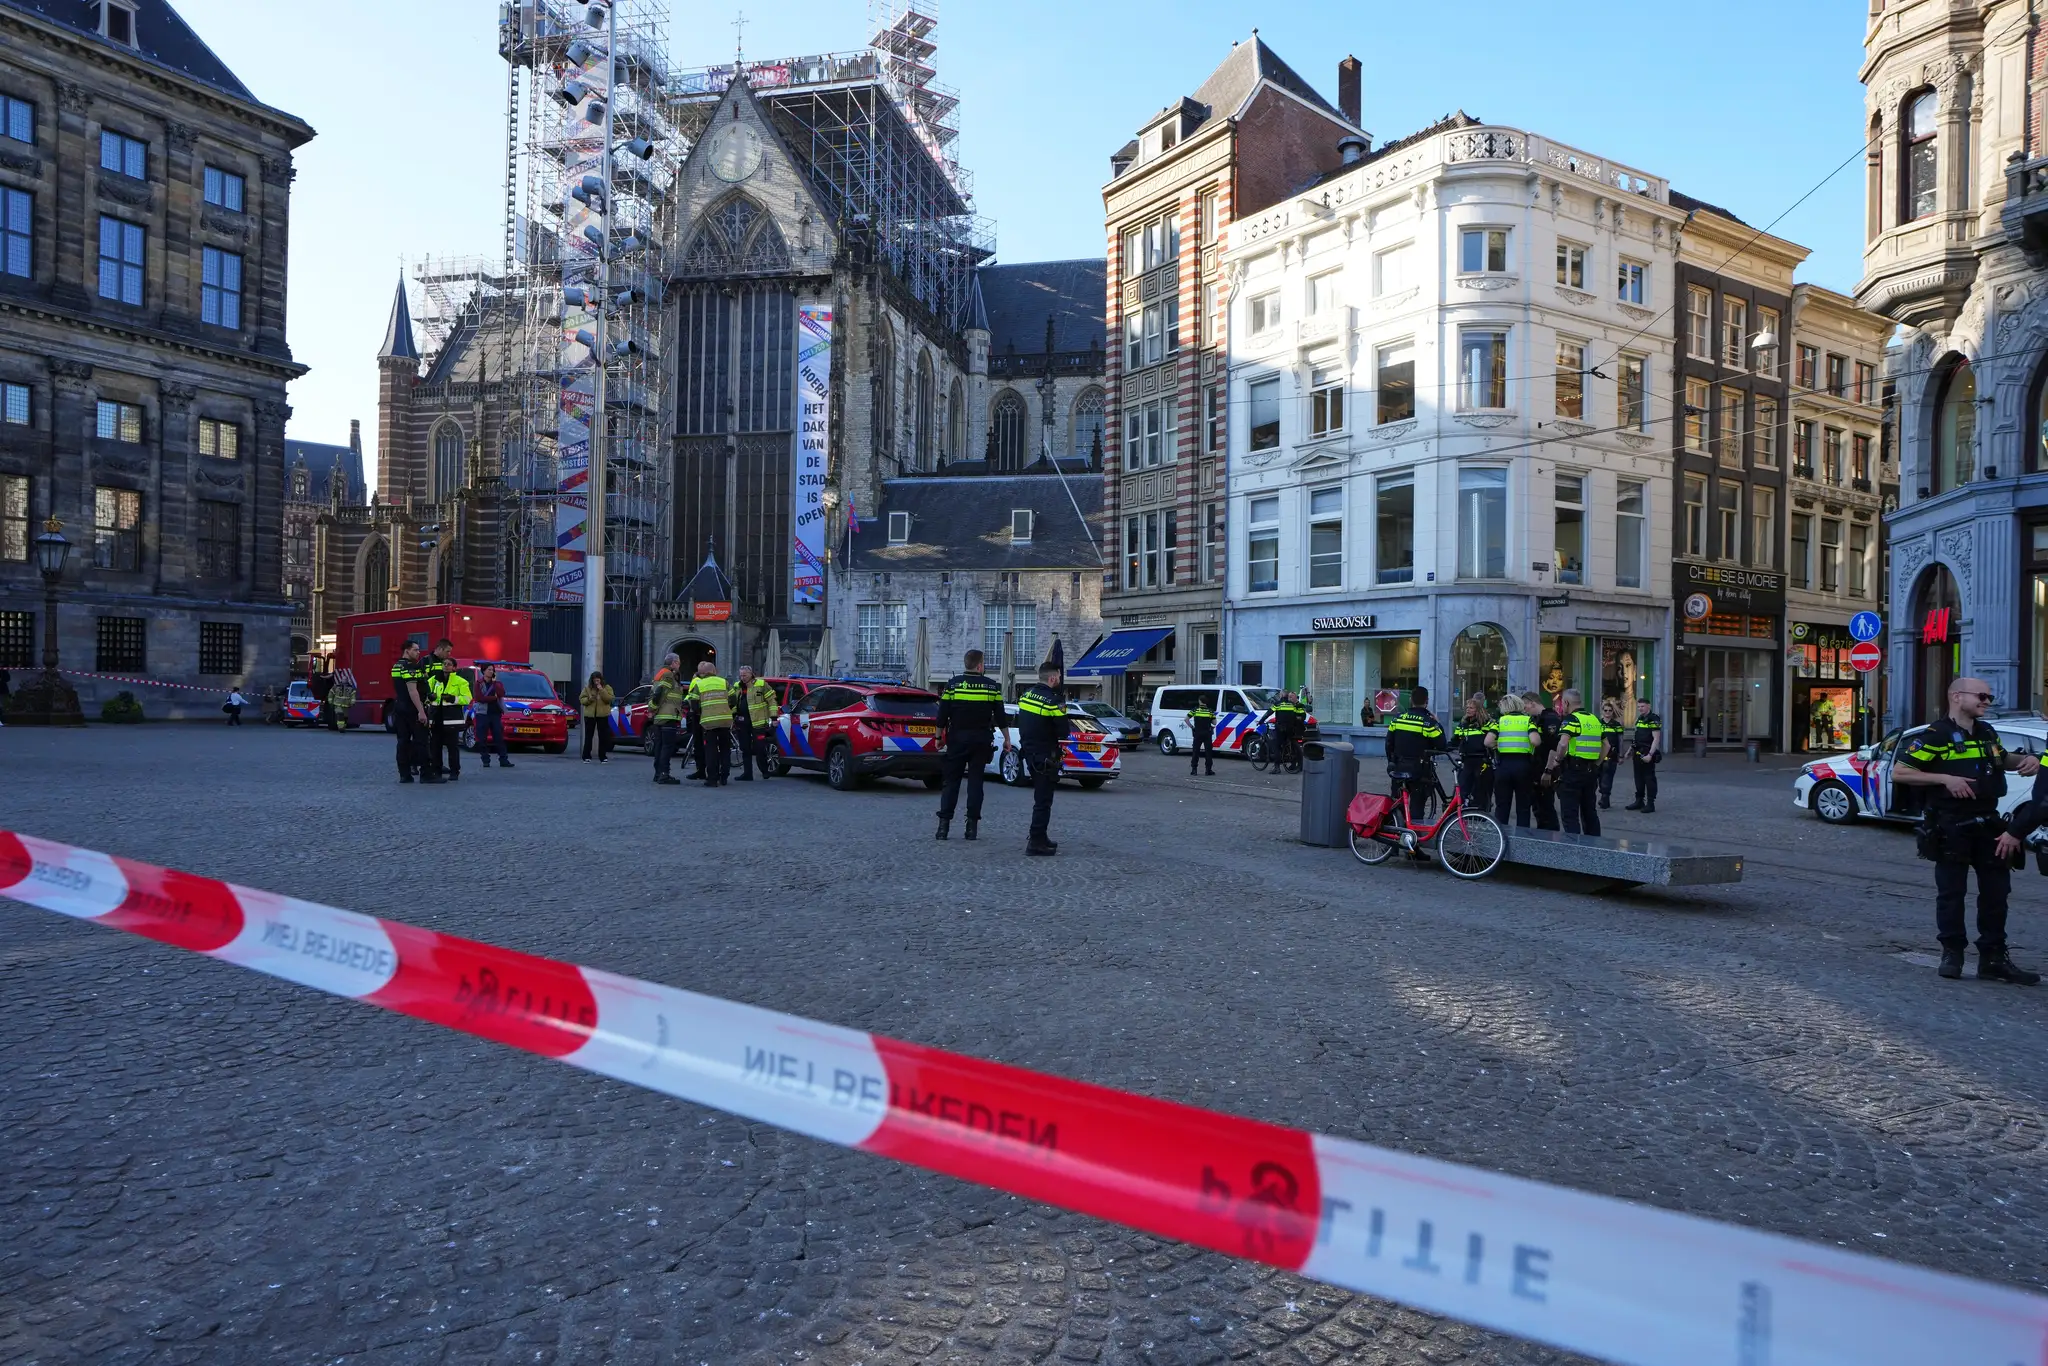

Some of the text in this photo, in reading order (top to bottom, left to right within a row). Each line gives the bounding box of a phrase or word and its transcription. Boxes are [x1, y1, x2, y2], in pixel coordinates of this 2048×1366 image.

[800, 365, 829, 401] HOERA
[804, 403, 825, 415] HET
[803, 420, 825, 433] DAK
[803, 438, 824, 450] VAN
[806, 456, 820, 468] DE
[799, 474, 826, 486] STAD
[807, 492, 818, 504] IS
[797, 505, 826, 526] OPEN
[803, 577, 814, 585] 750
[1746, 573, 1778, 589] MORE
[1314, 615, 1372, 630] SWAROVSKI
[1096, 648, 1134, 660] NAKED
